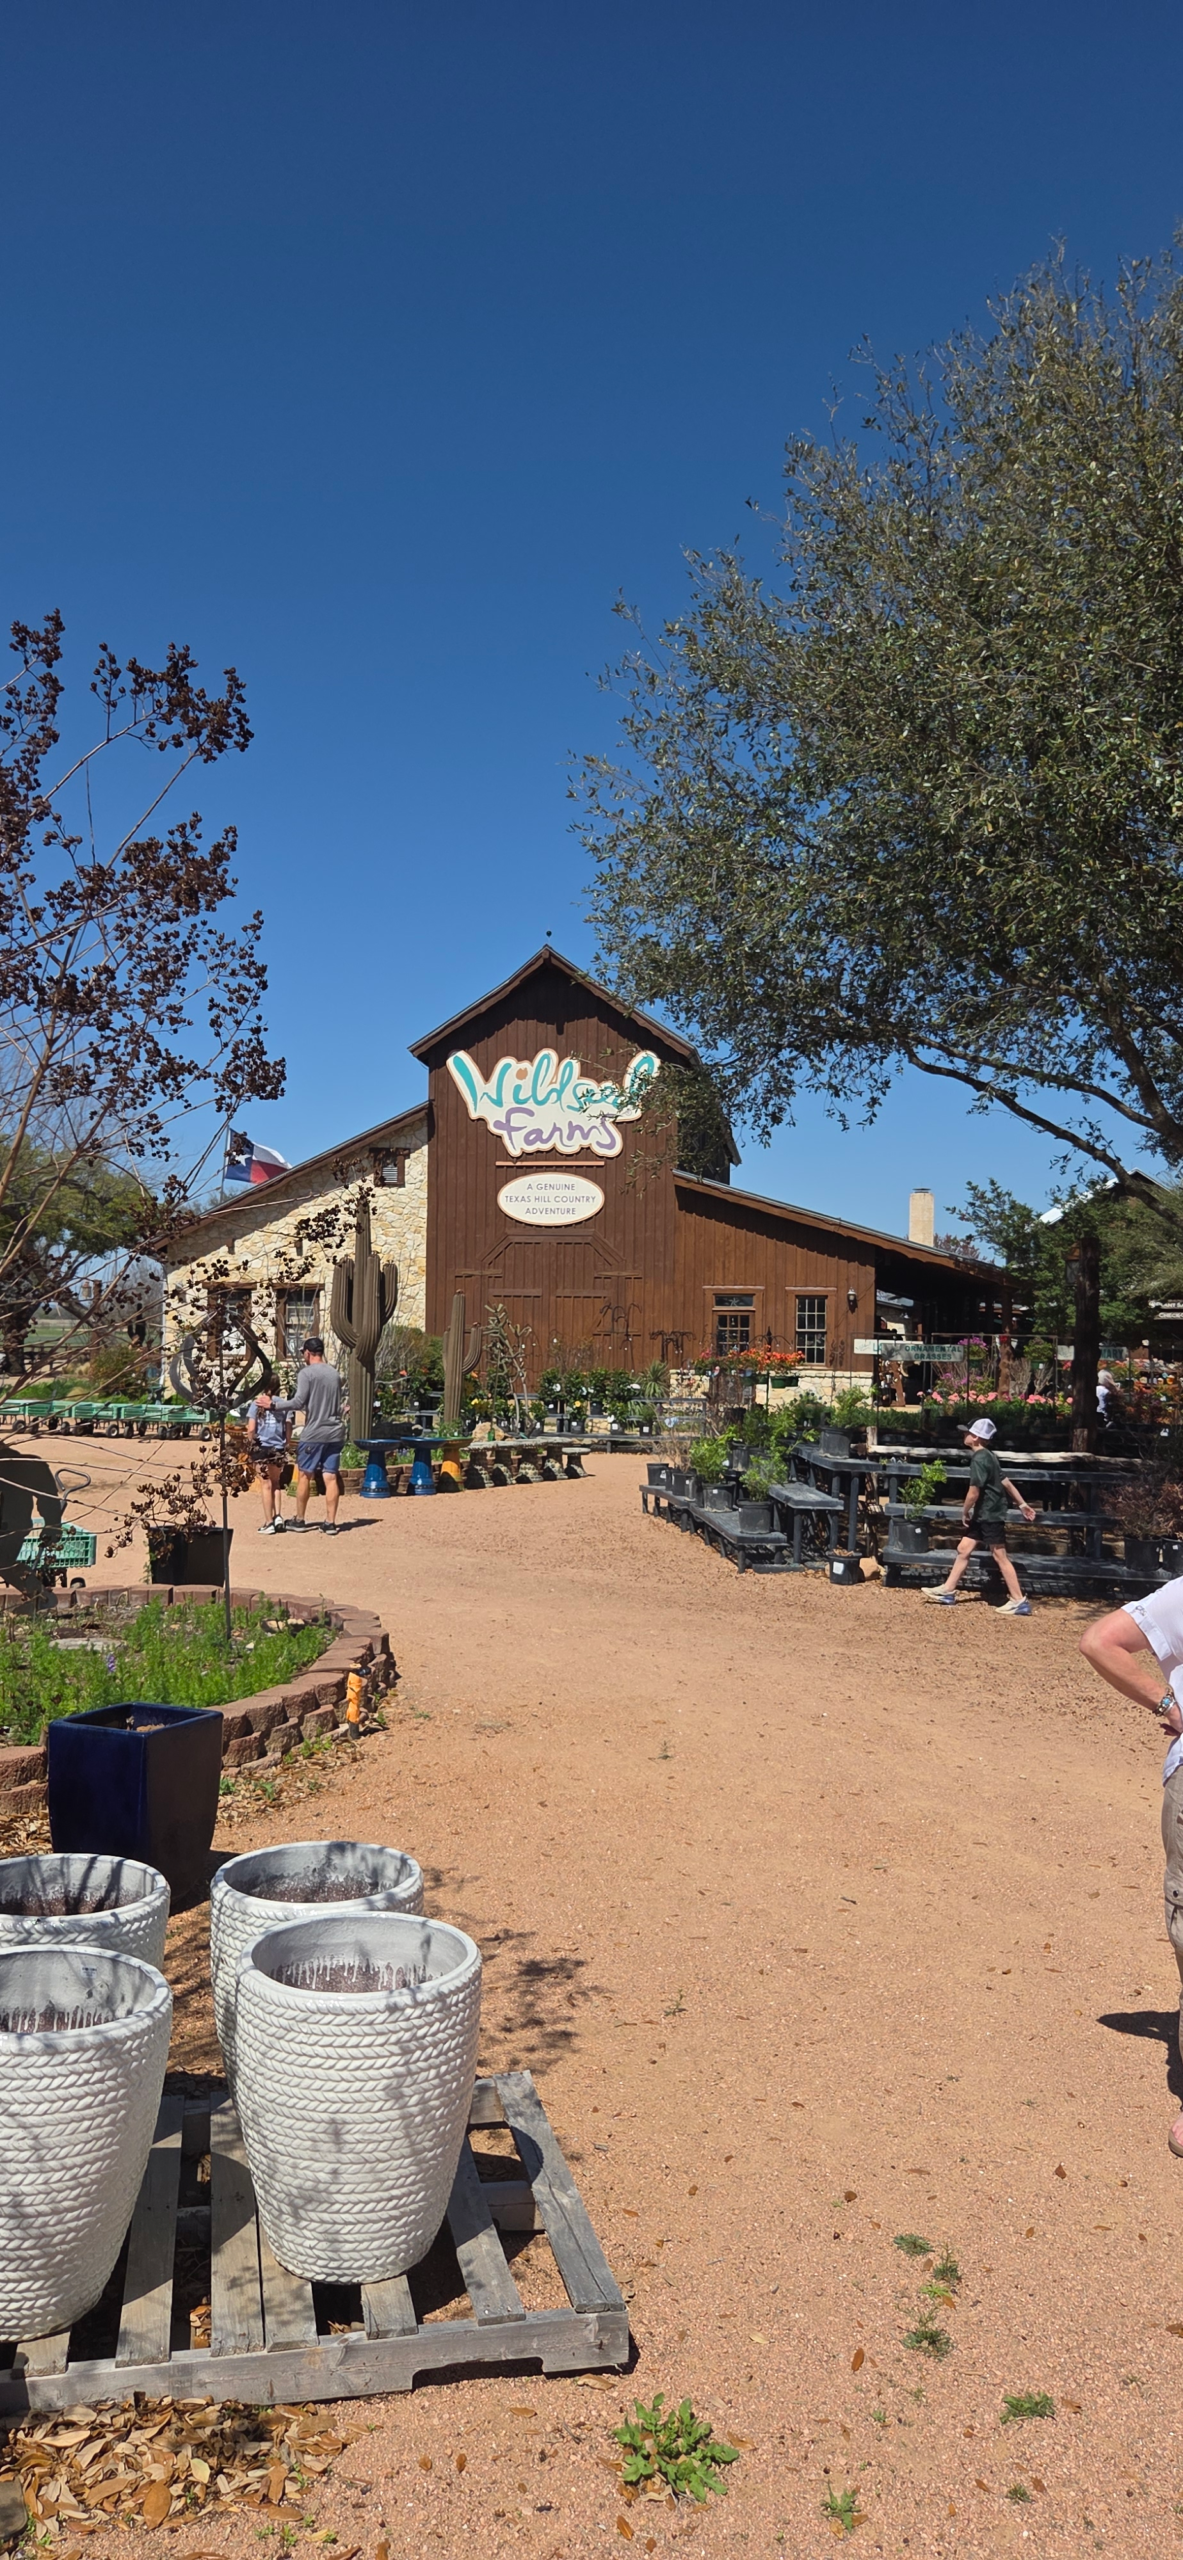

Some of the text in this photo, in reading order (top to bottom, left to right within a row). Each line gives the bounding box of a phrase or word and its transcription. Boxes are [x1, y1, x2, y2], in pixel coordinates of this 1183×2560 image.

[493, 1107, 617, 1151] Farms
[526, 1183, 576, 1191] A GENUINE
[505, 1195, 596, 1203] TEXAS HILL COUNTRY
[525, 1207, 576, 1216] ADVENTURE
[914, 1353, 952, 1361] GRASSES
[1100, 1348, 1124, 1359] MARY
